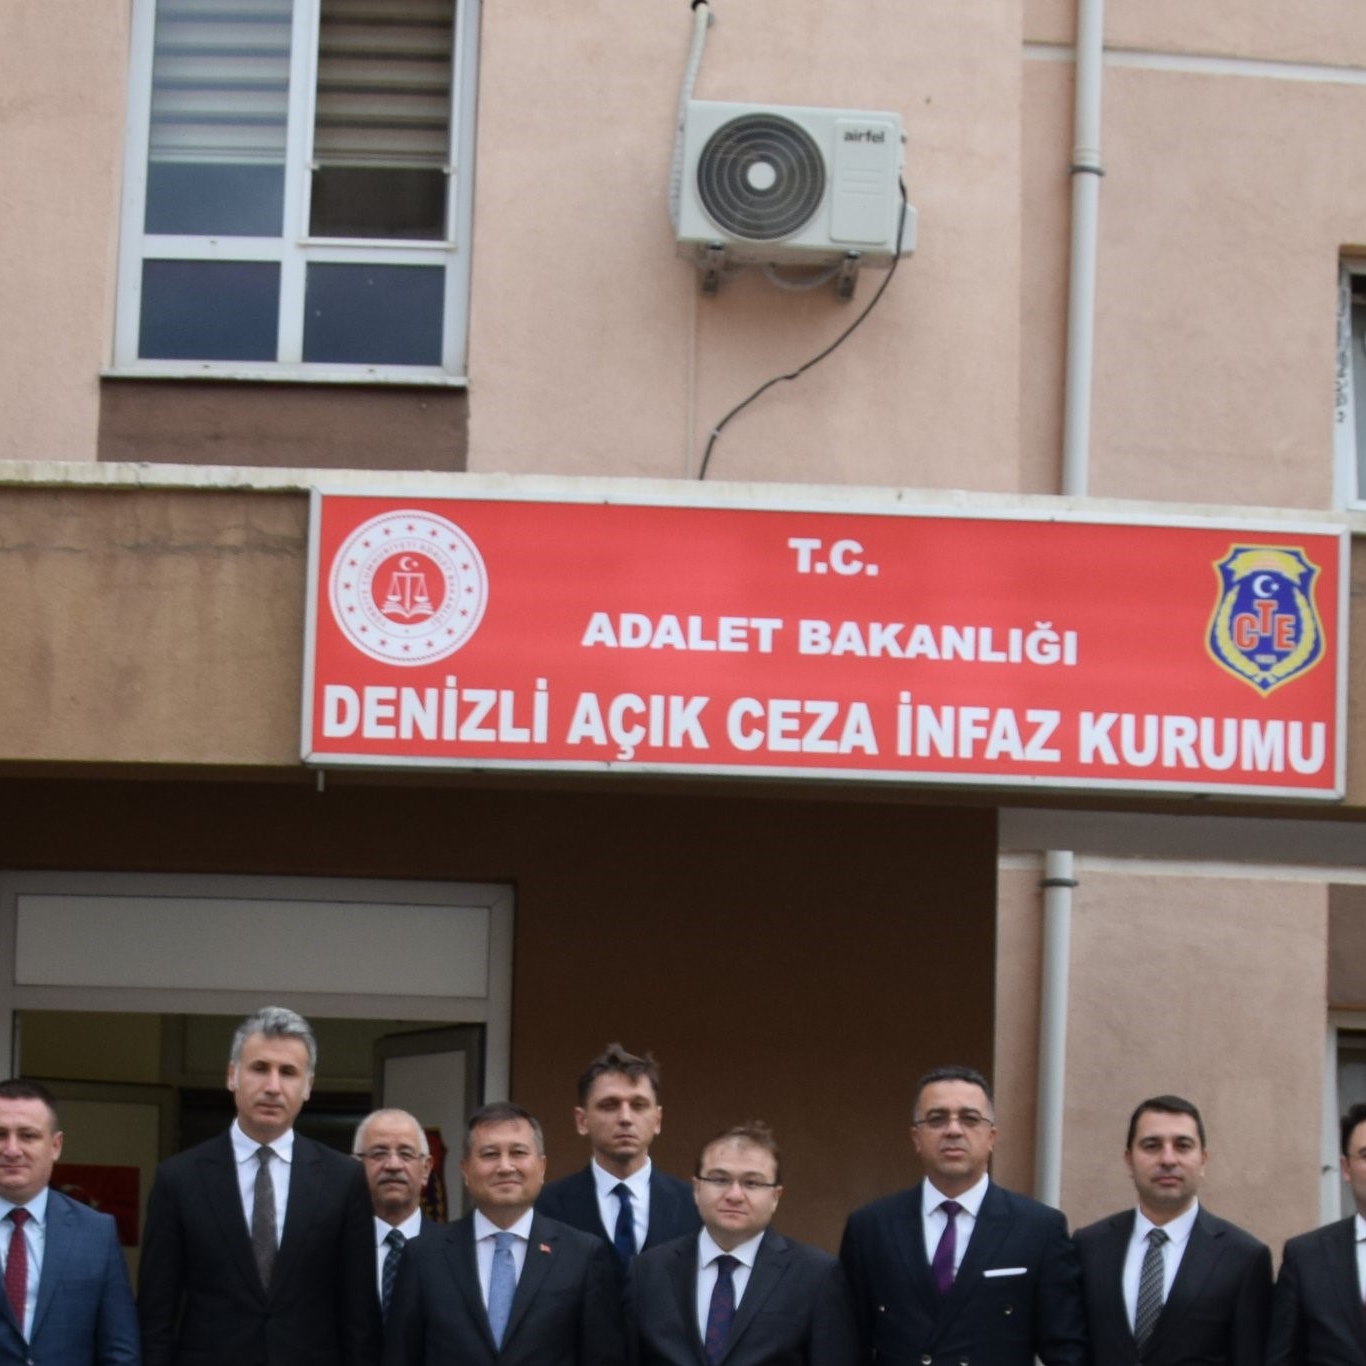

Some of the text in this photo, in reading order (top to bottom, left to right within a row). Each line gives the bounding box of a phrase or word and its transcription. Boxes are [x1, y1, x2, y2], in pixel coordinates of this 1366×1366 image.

[843, 129, 885, 143] airfel
[788, 537, 878, 576] T.C.
[581, 612, 1078, 666] ADALET BAKANLIĞI
[1233, 599, 1296, 651] CTE
[323, 676, 1326, 775] DENİZLİ AÇIK CEZA İNFAZ KURUMU
